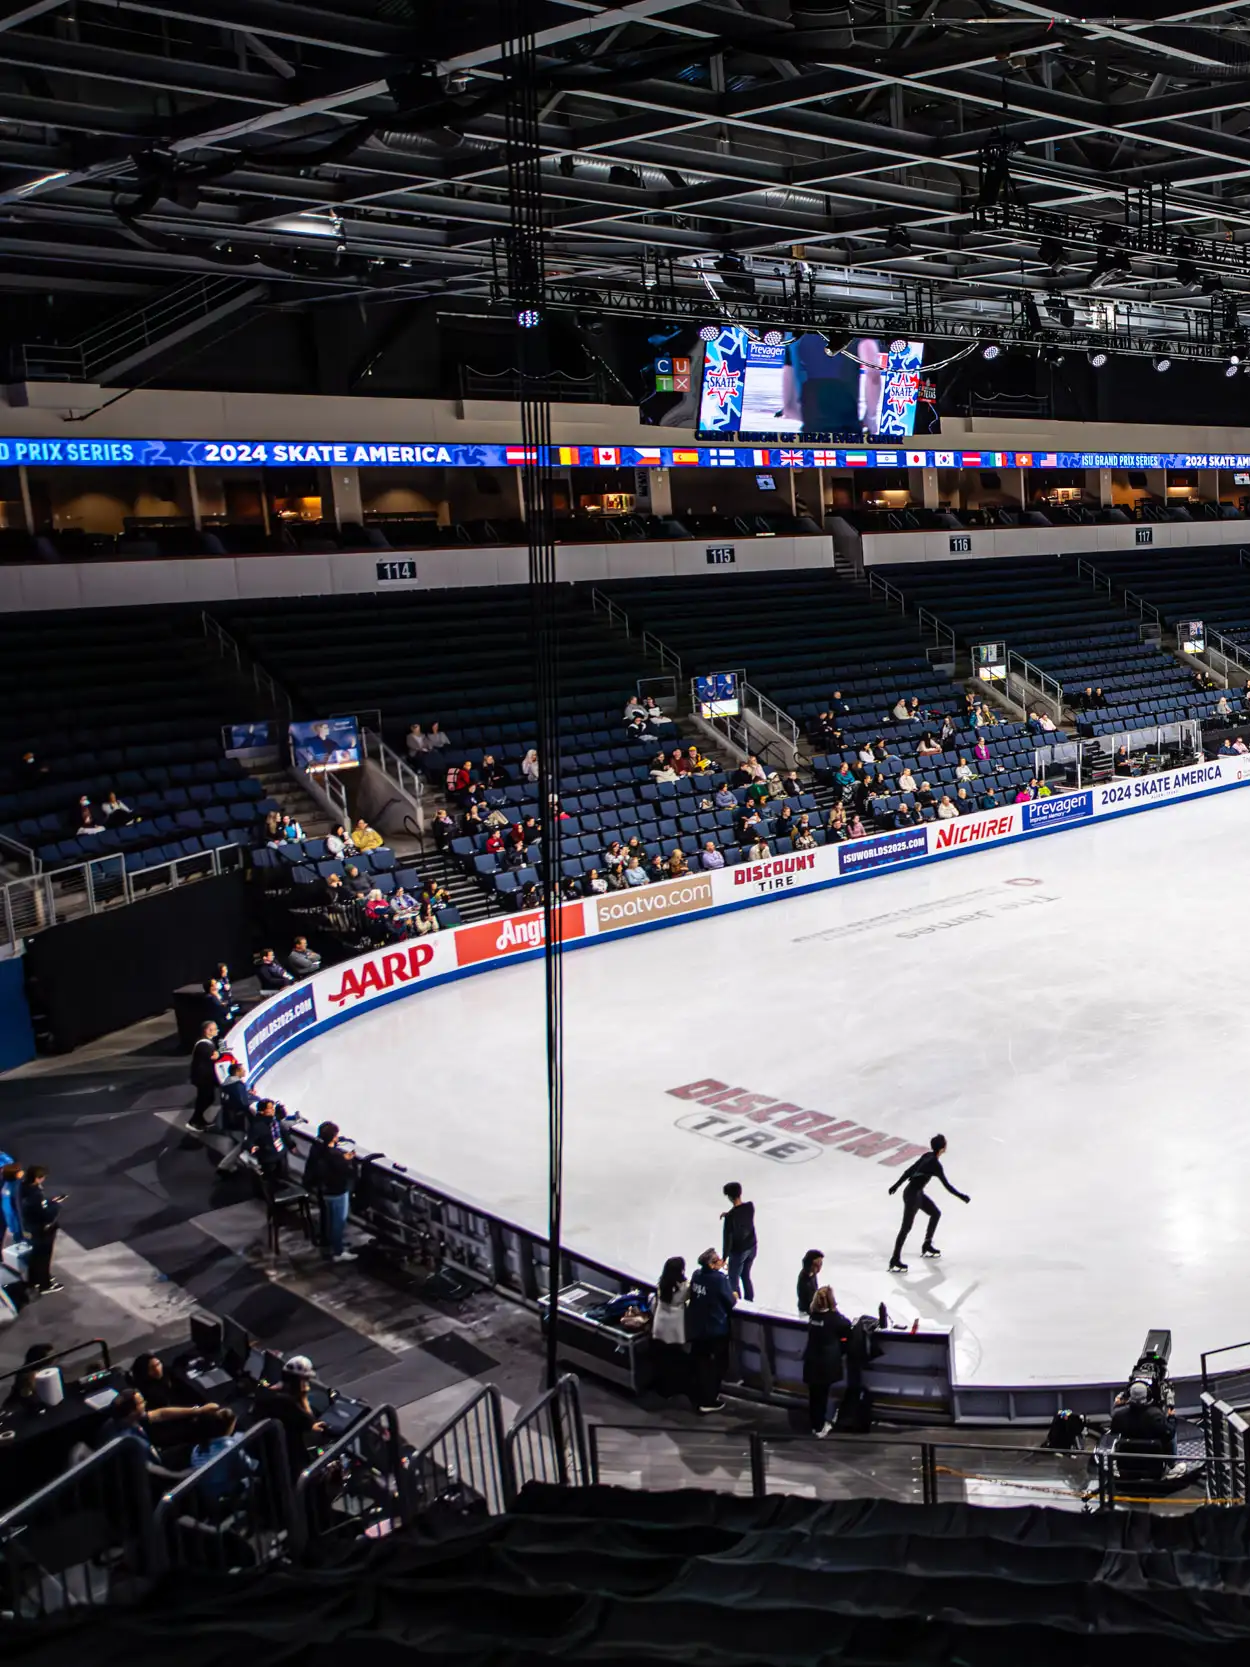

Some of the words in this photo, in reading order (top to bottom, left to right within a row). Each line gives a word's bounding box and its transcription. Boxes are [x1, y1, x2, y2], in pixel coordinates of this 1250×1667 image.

[709, 376, 737, 388] SKATE
[891, 386, 913, 397] SKATE
[16, 443, 61, 461] PRIX
[67, 443, 134, 461] SERIES
[205, 444, 268, 462] 2024
[273, 444, 348, 463] SKATE
[353, 446, 452, 463] AMERICA
[1082, 455, 1094, 466] ISU
[1094, 456, 1119, 466] GRAND
[1120, 456, 1135, 466] PRIX
[1136, 456, 1158, 466] SERIES
[1185, 456, 1208, 466] 2024
[1209, 456, 1236, 467] SKATE
[952, 538, 968, 552] 116
[1138, 531, 1150, 542] 117
[711, 550, 732, 564] 115
[384, 563, 411, 579] 114
[1102, 785, 1131, 805] 2024
[1134, 776, 1171, 798] SKATE
[1173, 765, 1222, 790] AMERICA
[1029, 798, 1086, 818] Prevagen
[936, 815, 1014, 850] NICHIREI
[843, 836, 925, 864] ISUWORLDS2025.COM
[734, 853, 816, 885] DISCOUNT
[758, 876, 794, 892] TIRE
[600, 884, 712, 922] saatva.com
[496, 914, 546, 950] Angi
[328, 943, 434, 1007] AARP
[665, 1078, 932, 1167] DISCOUNT
[691, 1115, 810, 1159] TIRE
